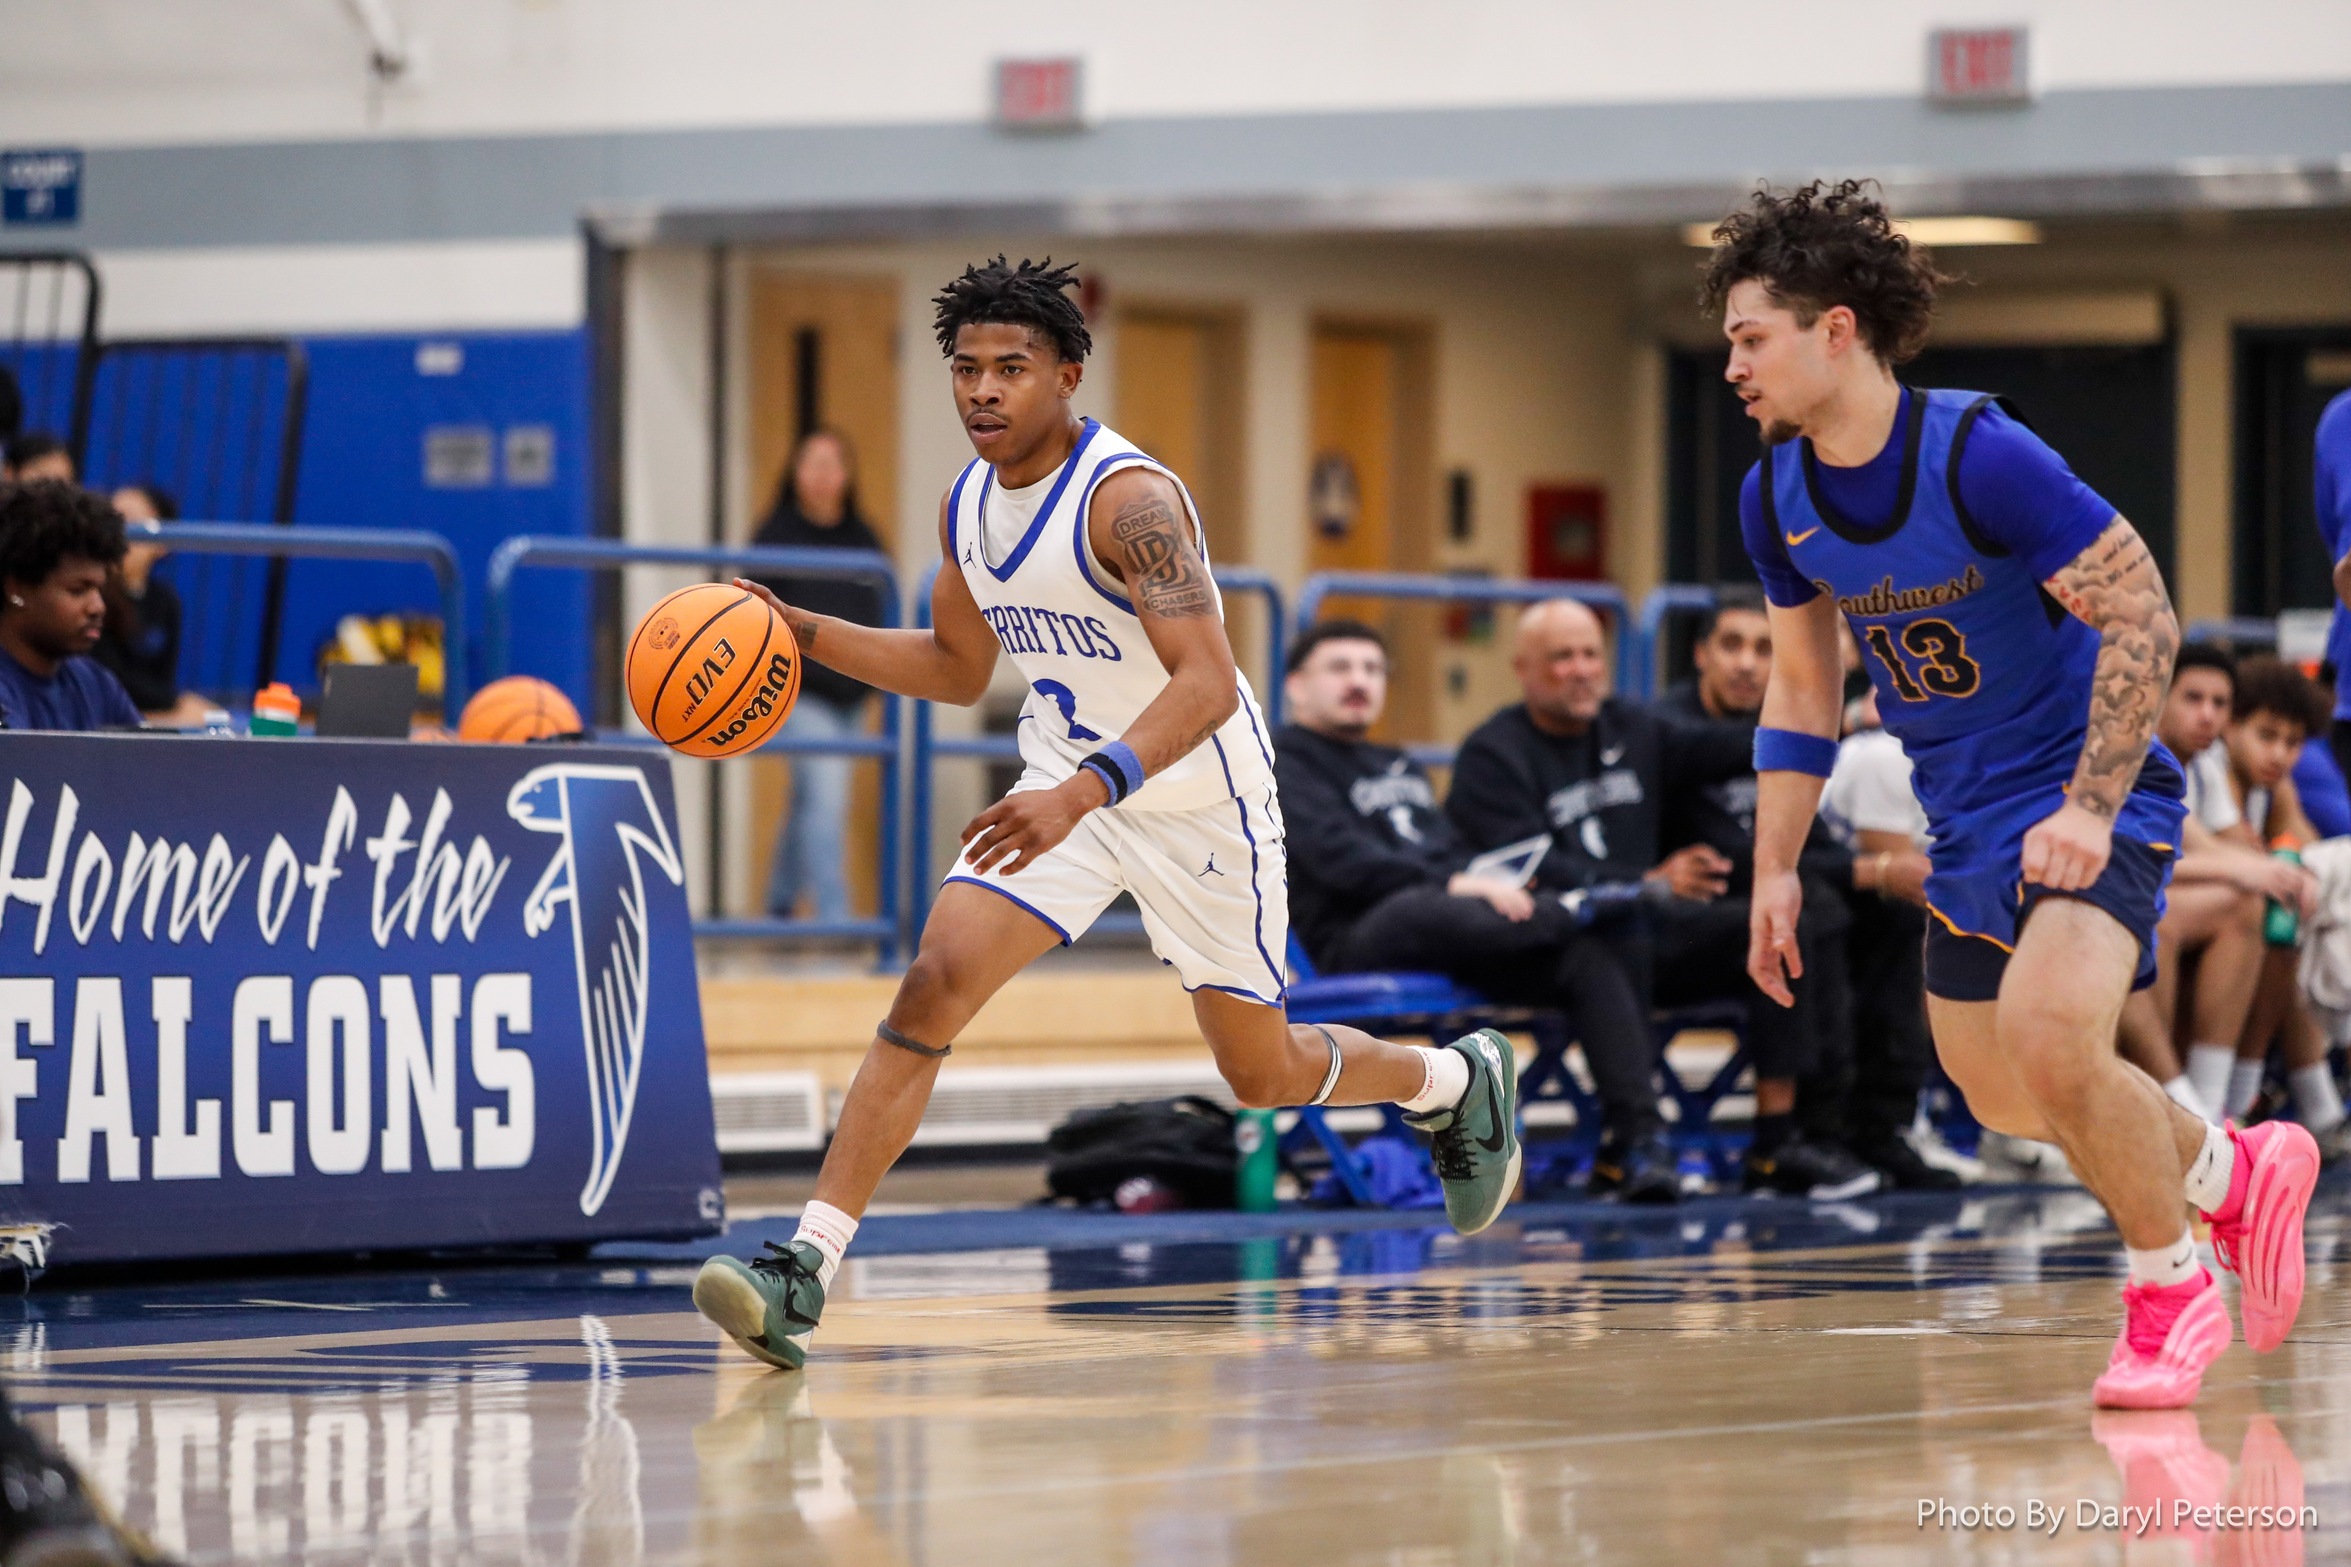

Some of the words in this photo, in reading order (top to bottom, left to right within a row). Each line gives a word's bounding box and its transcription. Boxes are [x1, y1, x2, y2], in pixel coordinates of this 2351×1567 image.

[1118, 507, 1172, 535] DREAM
[1150, 590, 1207, 610] CHASERS
[685, 636, 737, 706] EVO
[1865, 617, 1981, 702] 13
[682, 703, 698, 723] NXT
[706, 652, 791, 747] Wilson
[1032, 678, 1102, 741] 2
[0, 777, 251, 955] Home
[258, 785, 358, 949] of
[366, 786, 511, 948] the
[0, 973, 536, 1184] FALCONS
